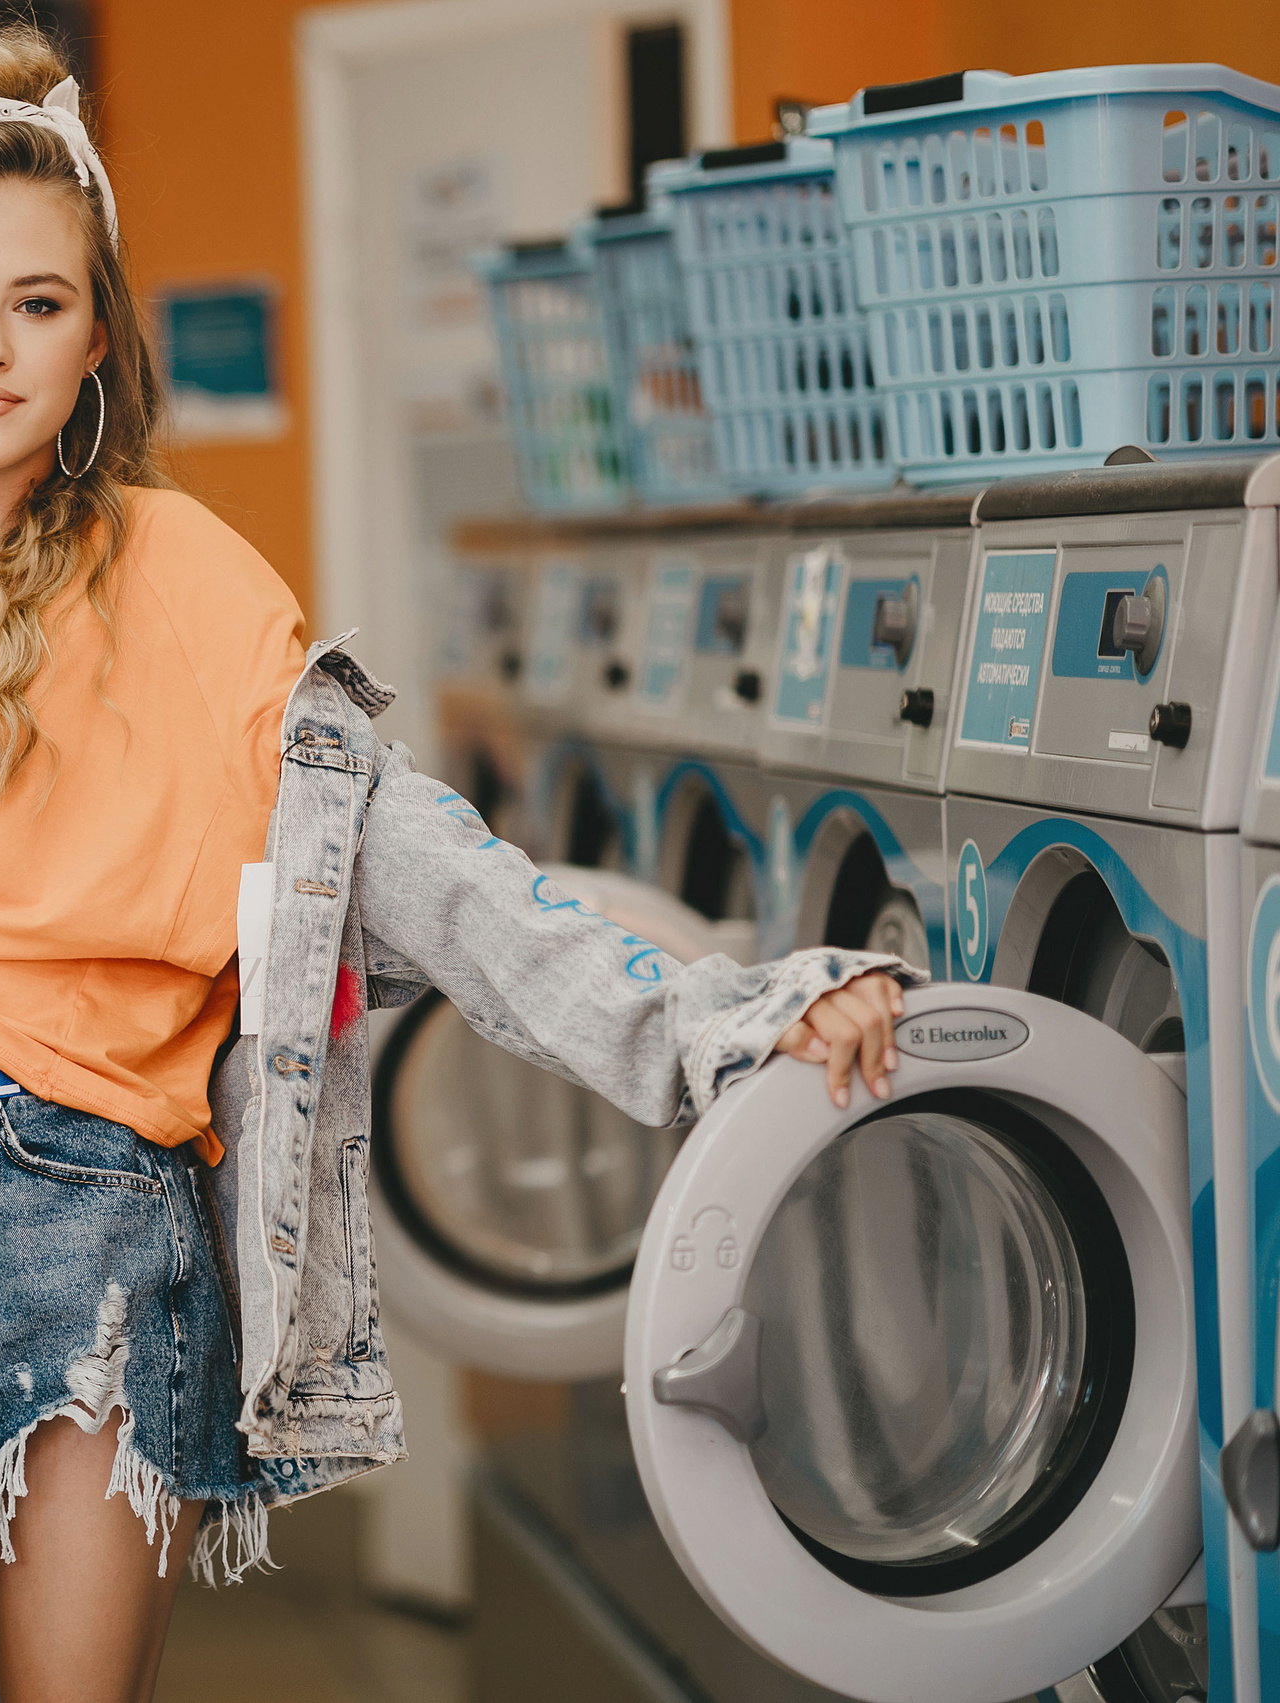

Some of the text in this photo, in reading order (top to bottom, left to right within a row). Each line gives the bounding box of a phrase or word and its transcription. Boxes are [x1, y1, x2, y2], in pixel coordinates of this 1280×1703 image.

[990, 627, 1026, 652] ПОДАЮТСЯ
[977, 662, 1030, 686] АВТОМАТИЧЕСКИ
[965, 863, 980, 957] 5
[929, 1025, 1008, 1043] Electrolux
